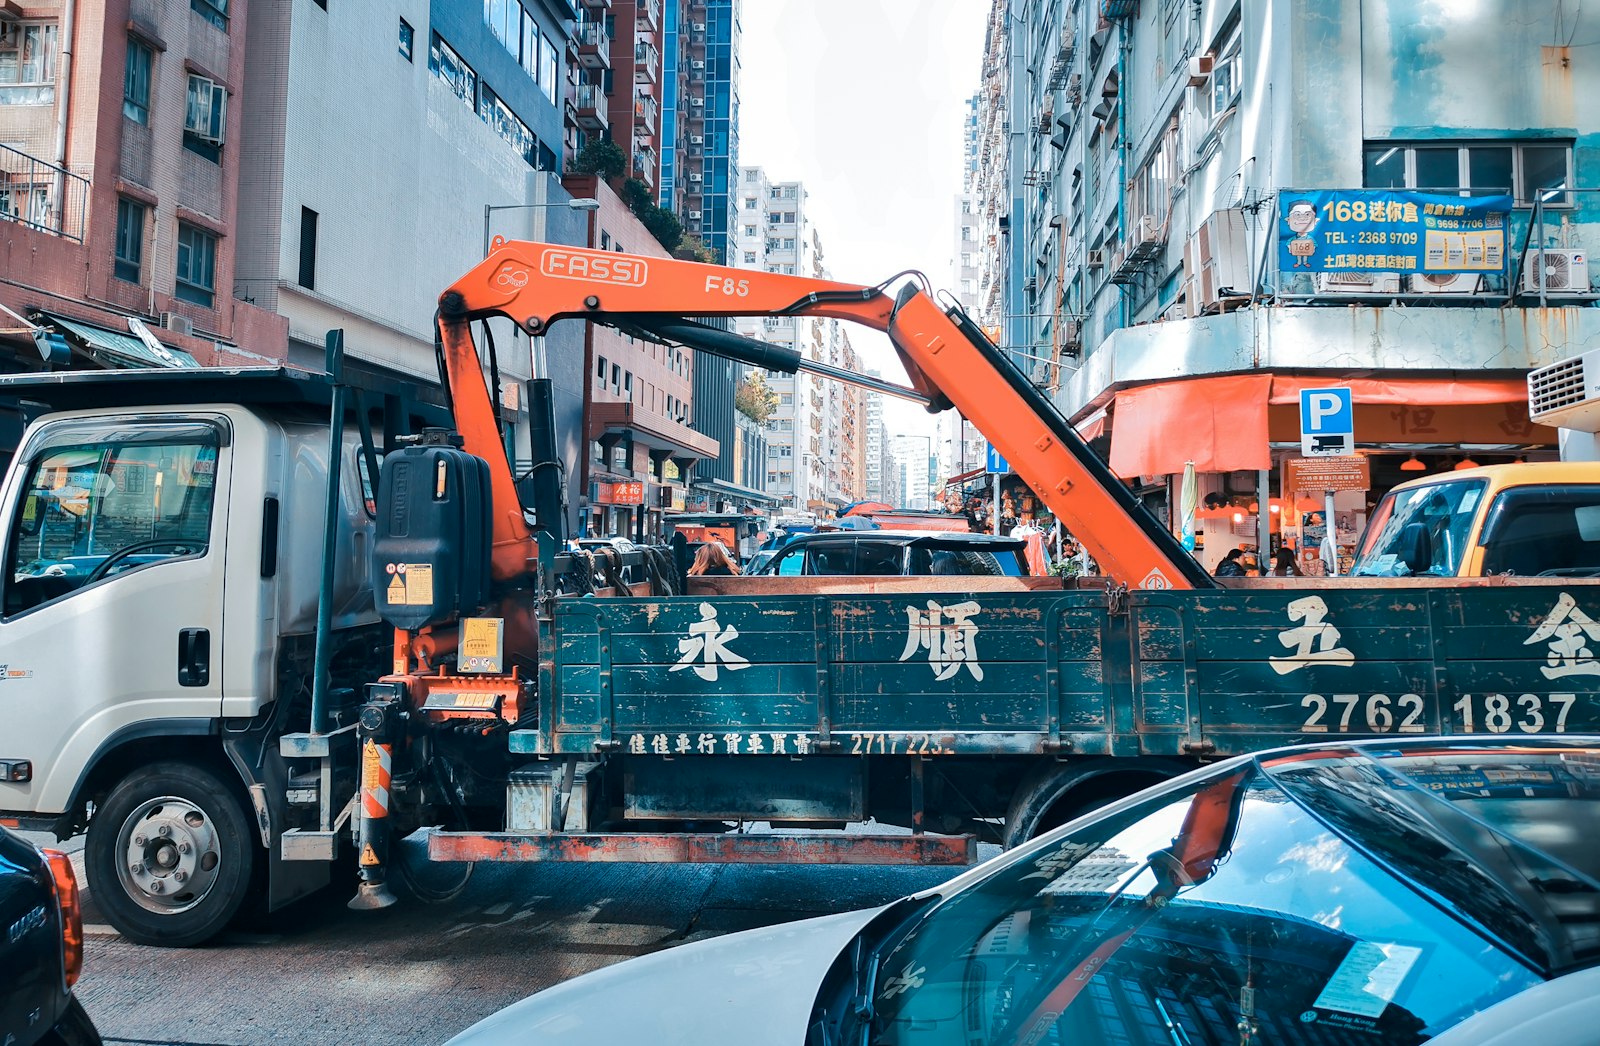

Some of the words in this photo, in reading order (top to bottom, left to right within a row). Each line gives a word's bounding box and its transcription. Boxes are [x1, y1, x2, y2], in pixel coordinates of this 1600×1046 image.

[1437, 220, 1459, 229] 9698
[1461, 219, 1483, 229] 7706
[1294, 242, 1311, 251] 168
[1358, 231, 1387, 244] 2368
[1389, 232, 1418, 245] 9709
[548, 253, 640, 283] FASSI
[704, 275, 750, 297] F85
[1309, 393, 1343, 431] P
[668, 601, 751, 682] 永
[898, 600, 984, 682] 順
[1268, 595, 1355, 675] 五
[1522, 592, 1600, 680] 金
[1300, 694, 1425, 733] 2762
[1453, 694, 1576, 733] 1837
[851, 733, 898, 754] 2717
[1329, 1013, 1353, 1023] Hong
[1353, 1017, 1376, 1027] Kong
